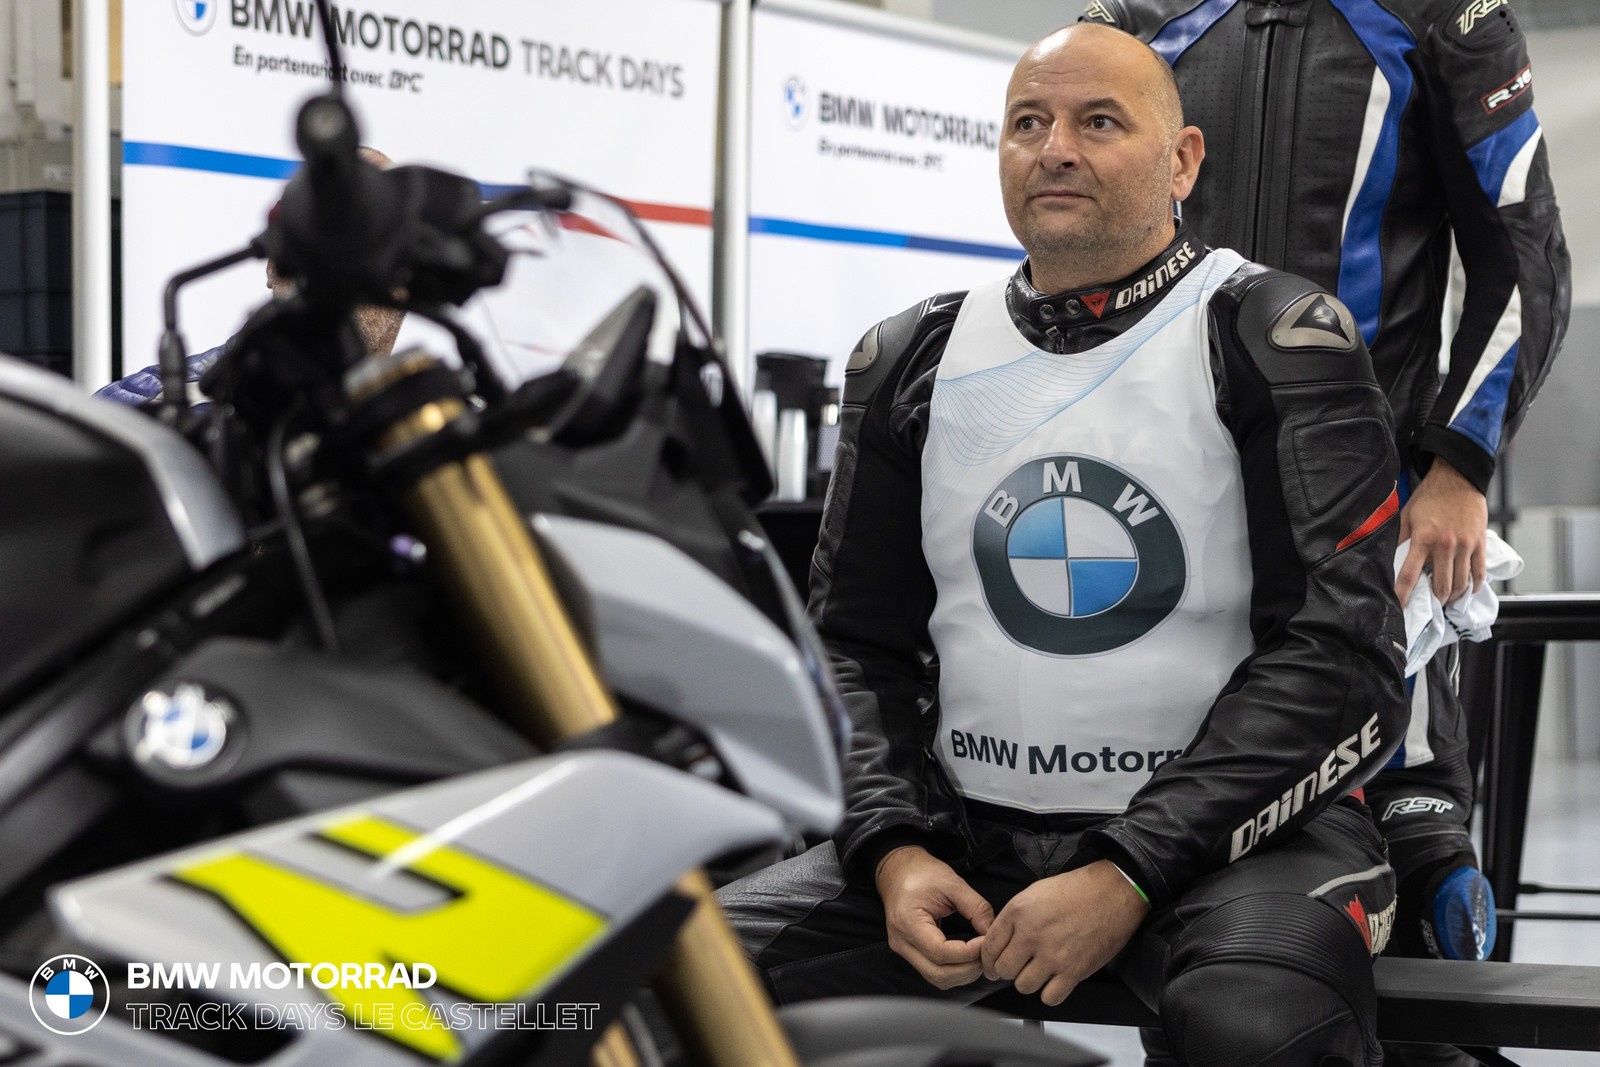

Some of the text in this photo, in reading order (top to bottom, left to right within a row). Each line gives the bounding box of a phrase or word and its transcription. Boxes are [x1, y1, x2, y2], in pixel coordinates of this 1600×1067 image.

[231, 0, 685, 99] BMW MOTORRAD TRACK DAYS
[233, 45, 253, 66] En
[350, 69, 385, 87] avec
[983, 460, 1161, 528] BMW
[951, 728, 1019, 770] BMW
[1381, 796, 1454, 821] RST
